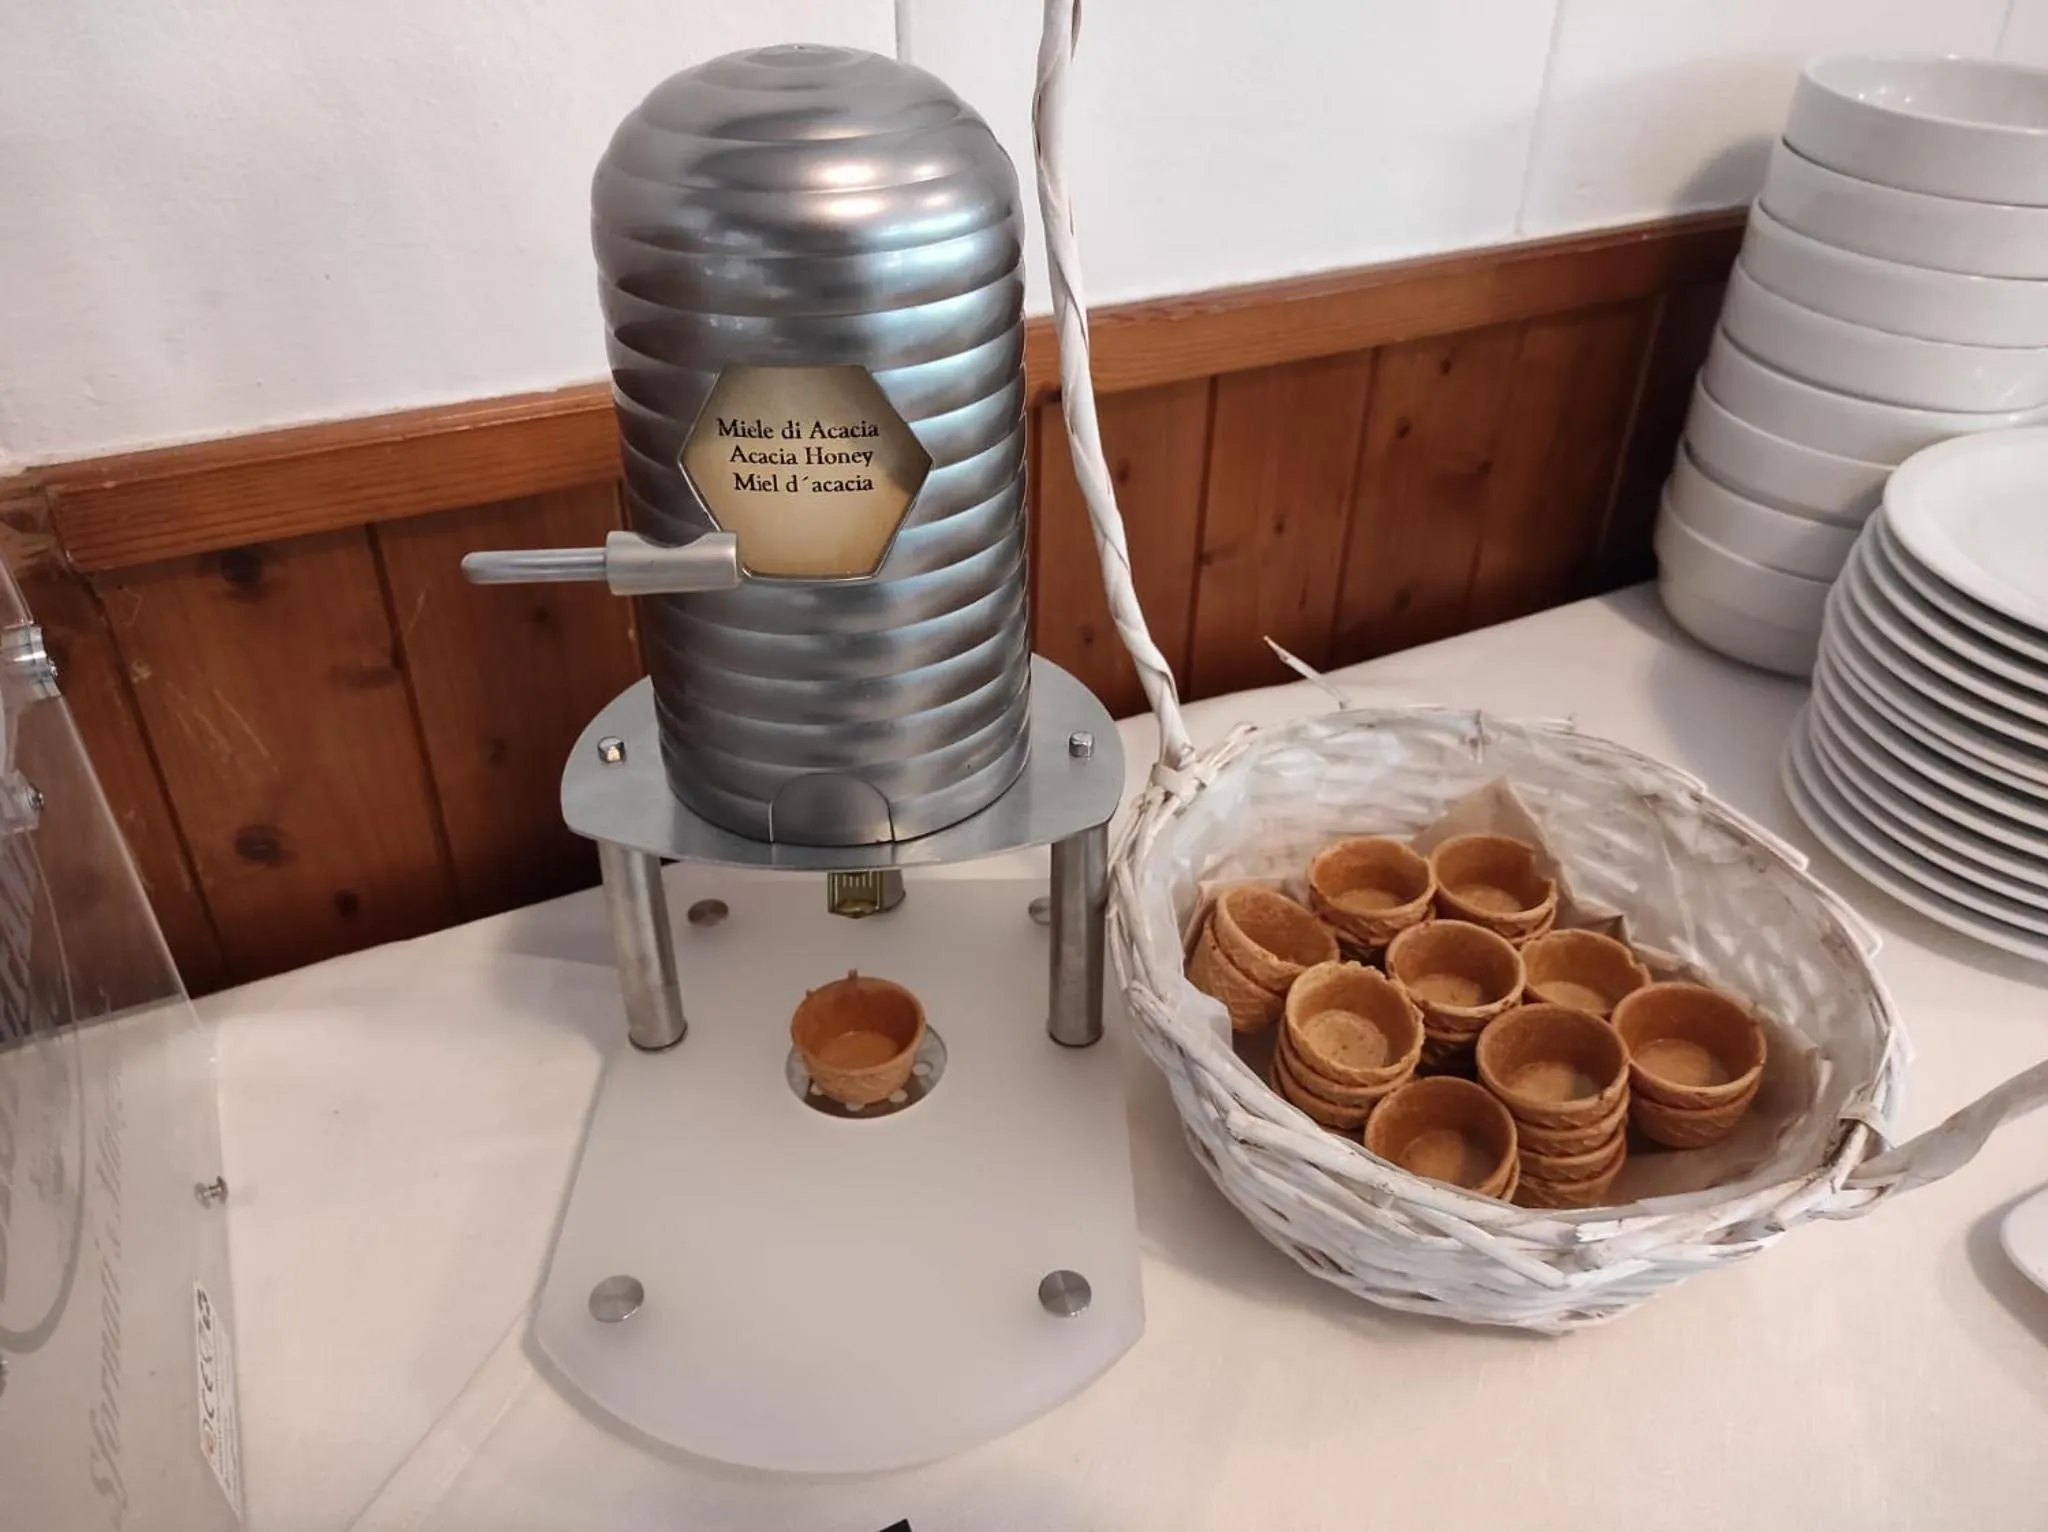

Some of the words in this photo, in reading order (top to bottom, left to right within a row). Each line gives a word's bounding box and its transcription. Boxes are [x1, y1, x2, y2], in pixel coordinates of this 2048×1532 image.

[716, 417, 775, 440] Miele
[780, 419, 802, 440] di
[809, 419, 880, 440] Acacia
[729, 445, 798, 466] Acacia
[804, 446, 874, 468] Honey
[732, 472, 778, 493] Miel
